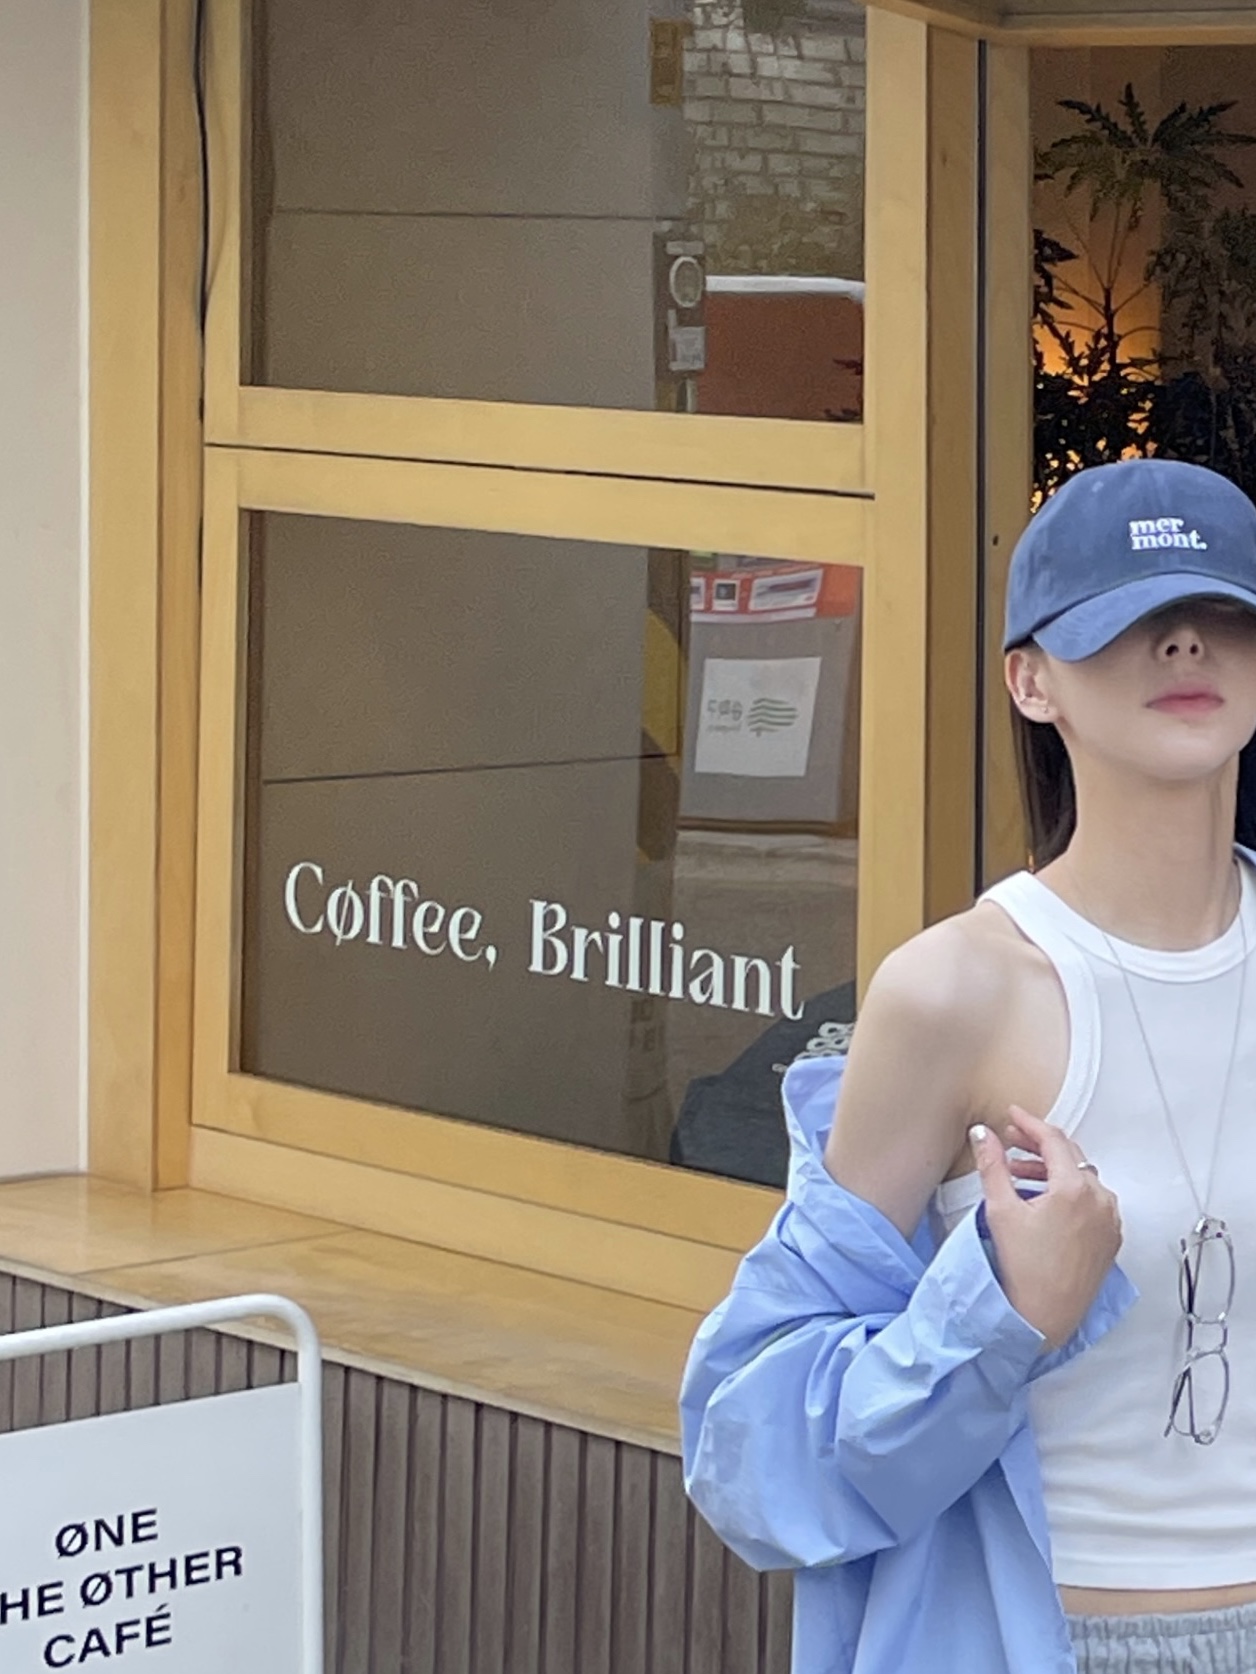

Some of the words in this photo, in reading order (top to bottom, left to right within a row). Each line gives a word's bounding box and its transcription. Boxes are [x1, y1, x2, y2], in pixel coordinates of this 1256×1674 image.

[1129, 517, 1184, 535] mer
[1131, 530, 1208, 550] mont.
[527, 898, 806, 1021] Brilliant
[55, 1508, 159, 1560] ØNE
[0, 1580, 65, 1625] HE
[80, 1545, 244, 1609] ØTHER
[43, 1602, 172, 1669] CAFÉ
